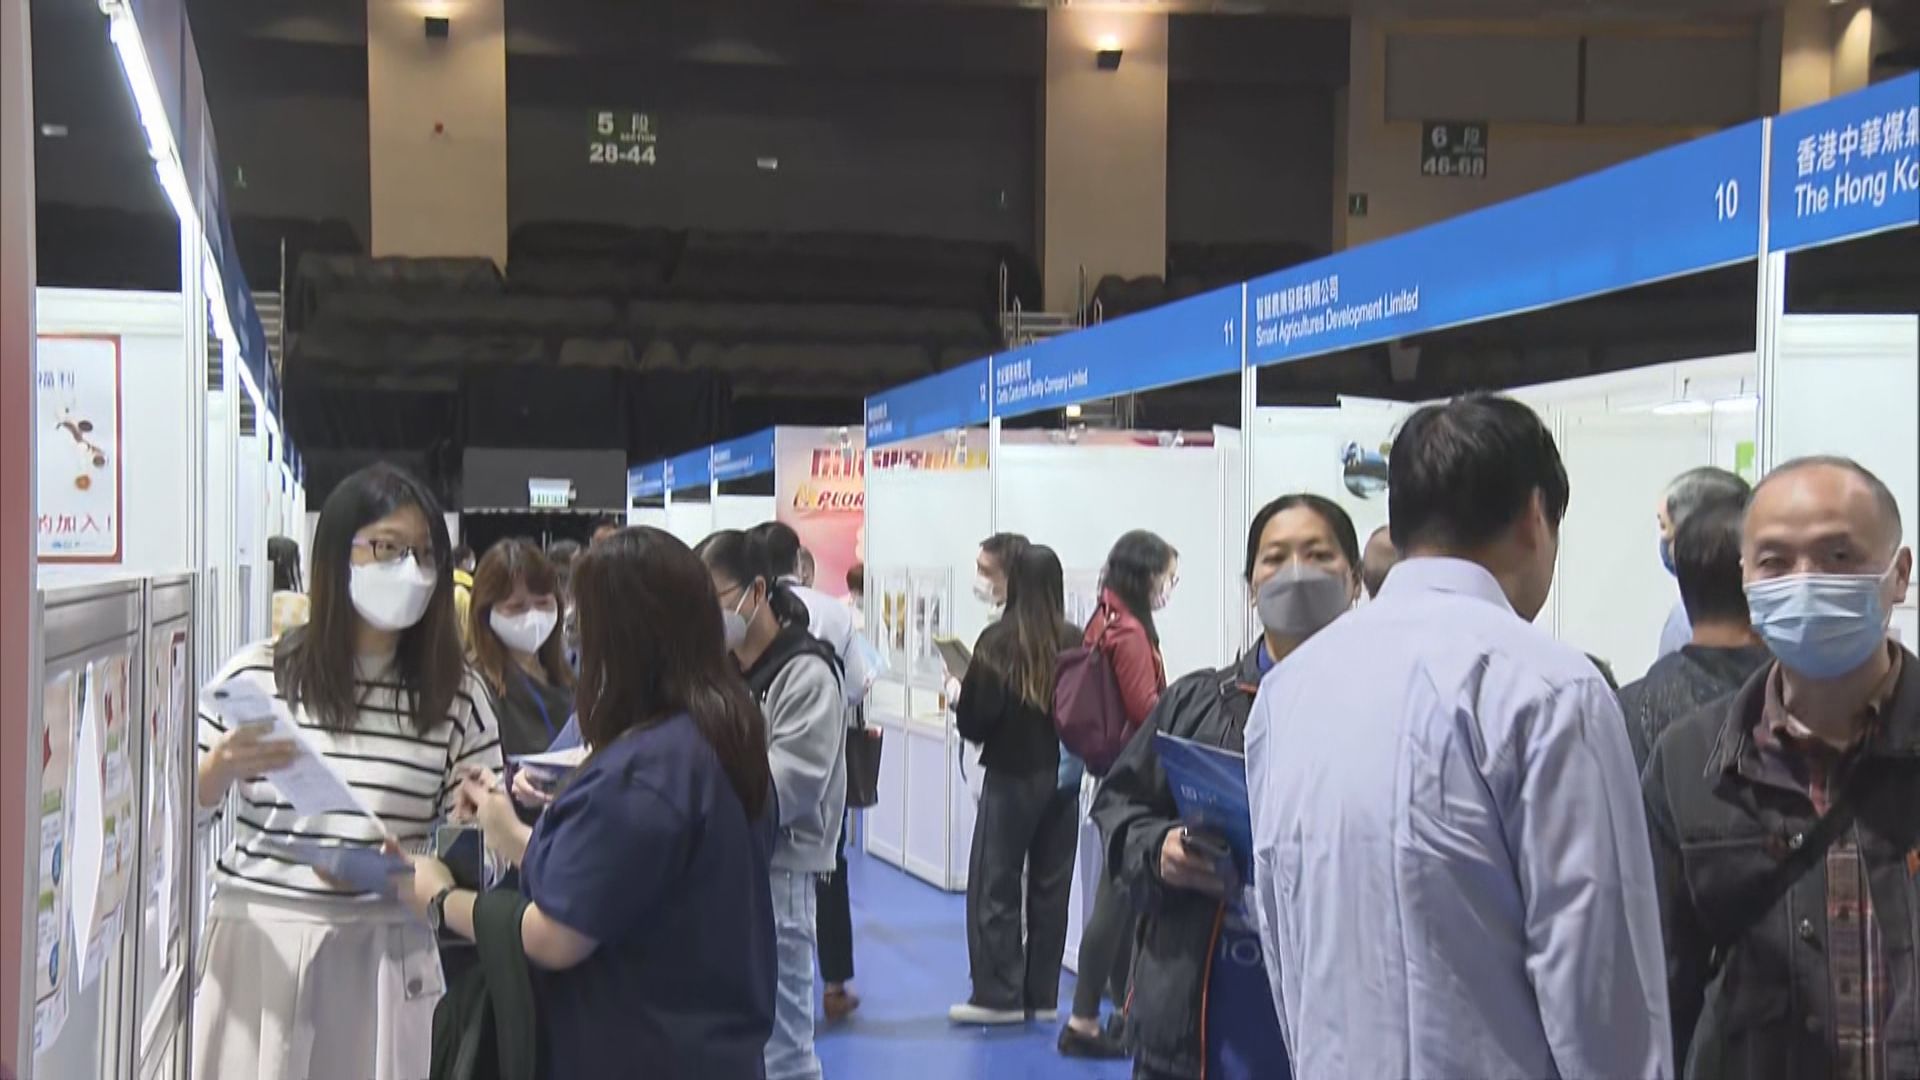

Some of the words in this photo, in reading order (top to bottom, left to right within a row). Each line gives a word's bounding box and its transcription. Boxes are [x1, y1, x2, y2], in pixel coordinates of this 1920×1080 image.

[597, 112, 614, 135] 5
[1432, 126, 1447, 148] 6
[590, 142, 657, 164] 28-44
[1714, 179, 1738, 221] 10
[1794, 182, 1829, 218] The
[1834, 171, 1888, 208] Hong
[1256, 321, 1278, 347] Smart
[1278, 312, 1325, 346] Agricultures
[1326, 297, 1382, 330] Development
[1384, 285, 1419, 317] Limited
[1224, 317, 1233, 346] 11
